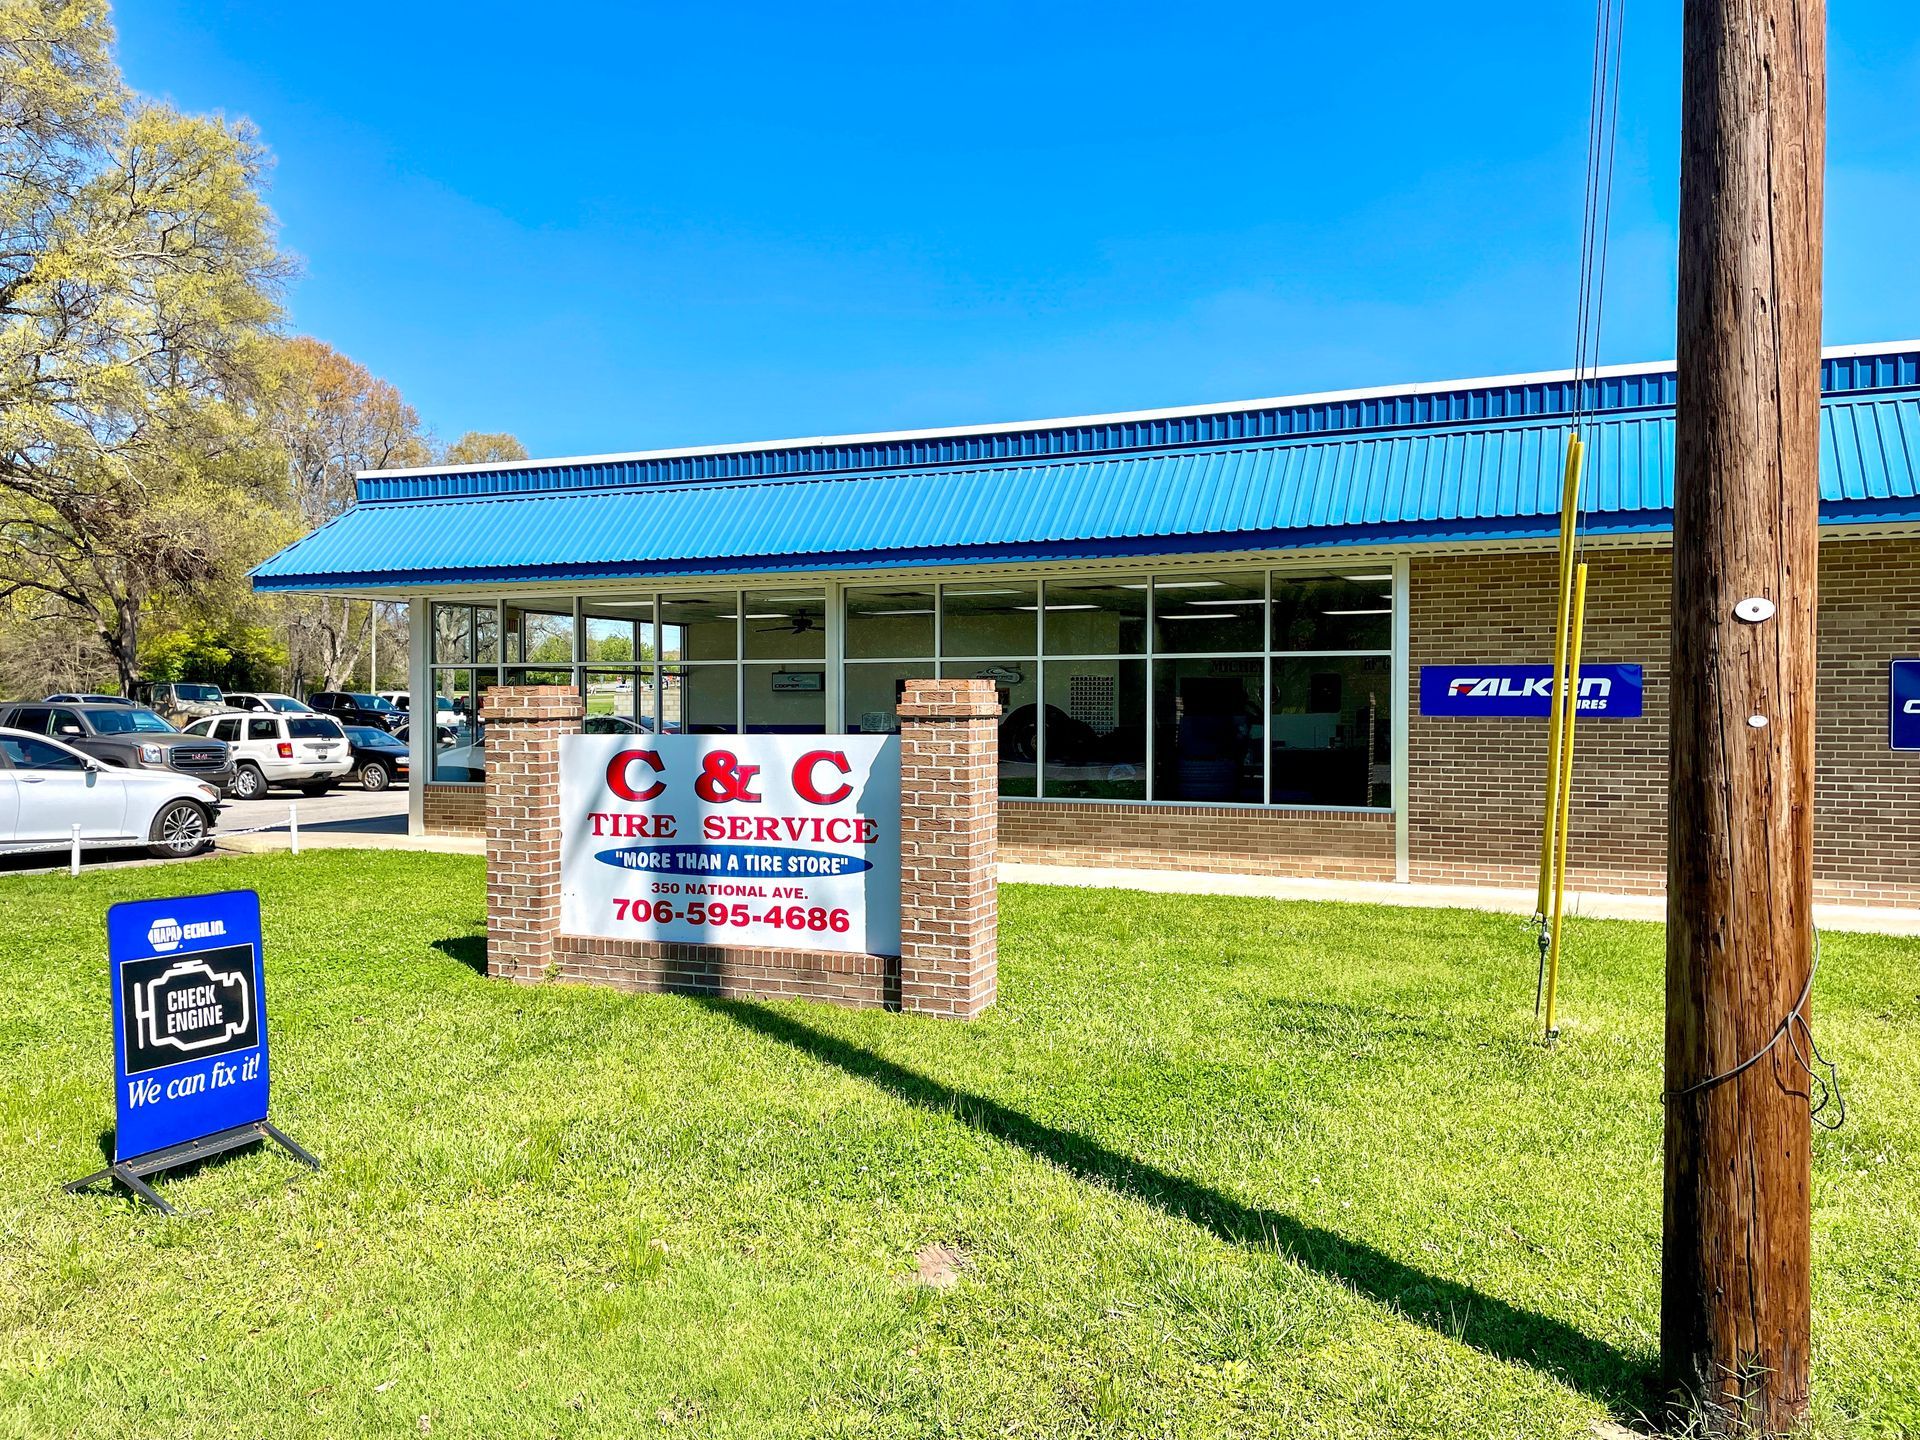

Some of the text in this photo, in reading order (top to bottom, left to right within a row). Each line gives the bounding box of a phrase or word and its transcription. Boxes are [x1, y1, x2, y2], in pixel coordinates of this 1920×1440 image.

[1447, 677, 1612, 697] FALKN
[1575, 699, 1608, 710] IRES
[606, 749, 854, 806] C & C
[587, 812, 880, 844] TIRE SERVICE
[615, 850, 849, 875] "MORE THAN A TIRE STORE"
[650, 882, 809, 900] 350 NATIONAL AVE.
[612, 898, 851, 933] 706-595-4686
[152, 925, 178, 944] NAPA
[167, 984, 217, 1012] CHECK
[167, 1004, 224, 1034] ENGINE
[128, 1052, 261, 1109] We can fix it!
